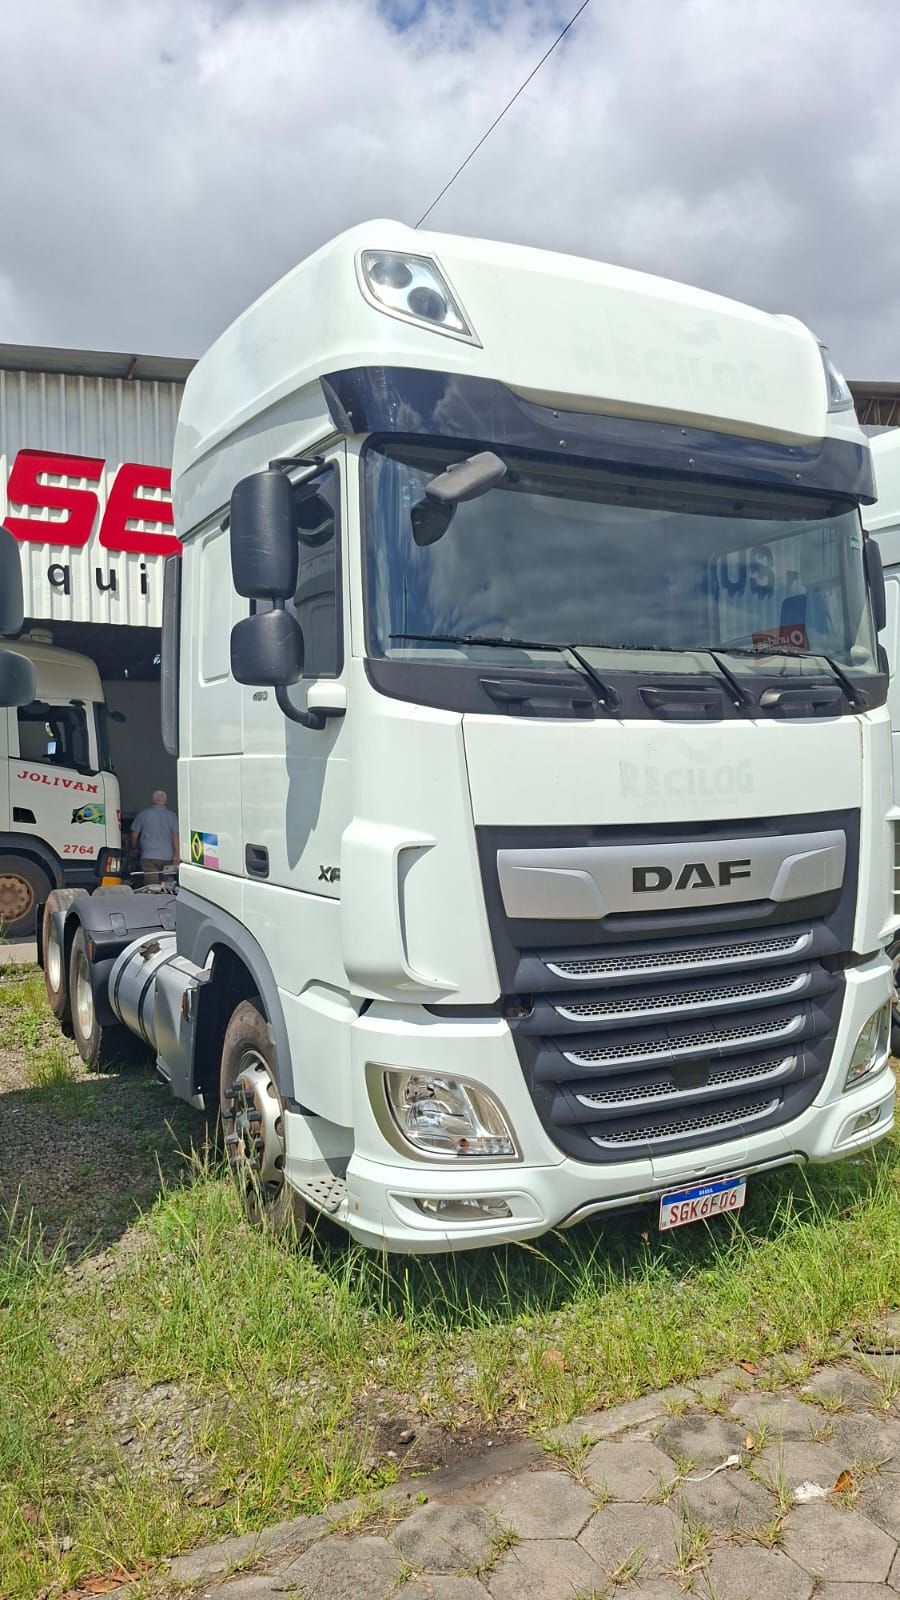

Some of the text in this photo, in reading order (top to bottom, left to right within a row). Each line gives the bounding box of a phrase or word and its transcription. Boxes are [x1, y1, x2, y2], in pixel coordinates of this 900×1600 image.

[17, 771, 99, 794] JOLIVAN
[618, 757, 756, 799] RECILOG
[63, 844, 95, 855] 2764
[632, 859, 752, 893] DAF
[669, 1189, 737, 1225] SGK6F06
